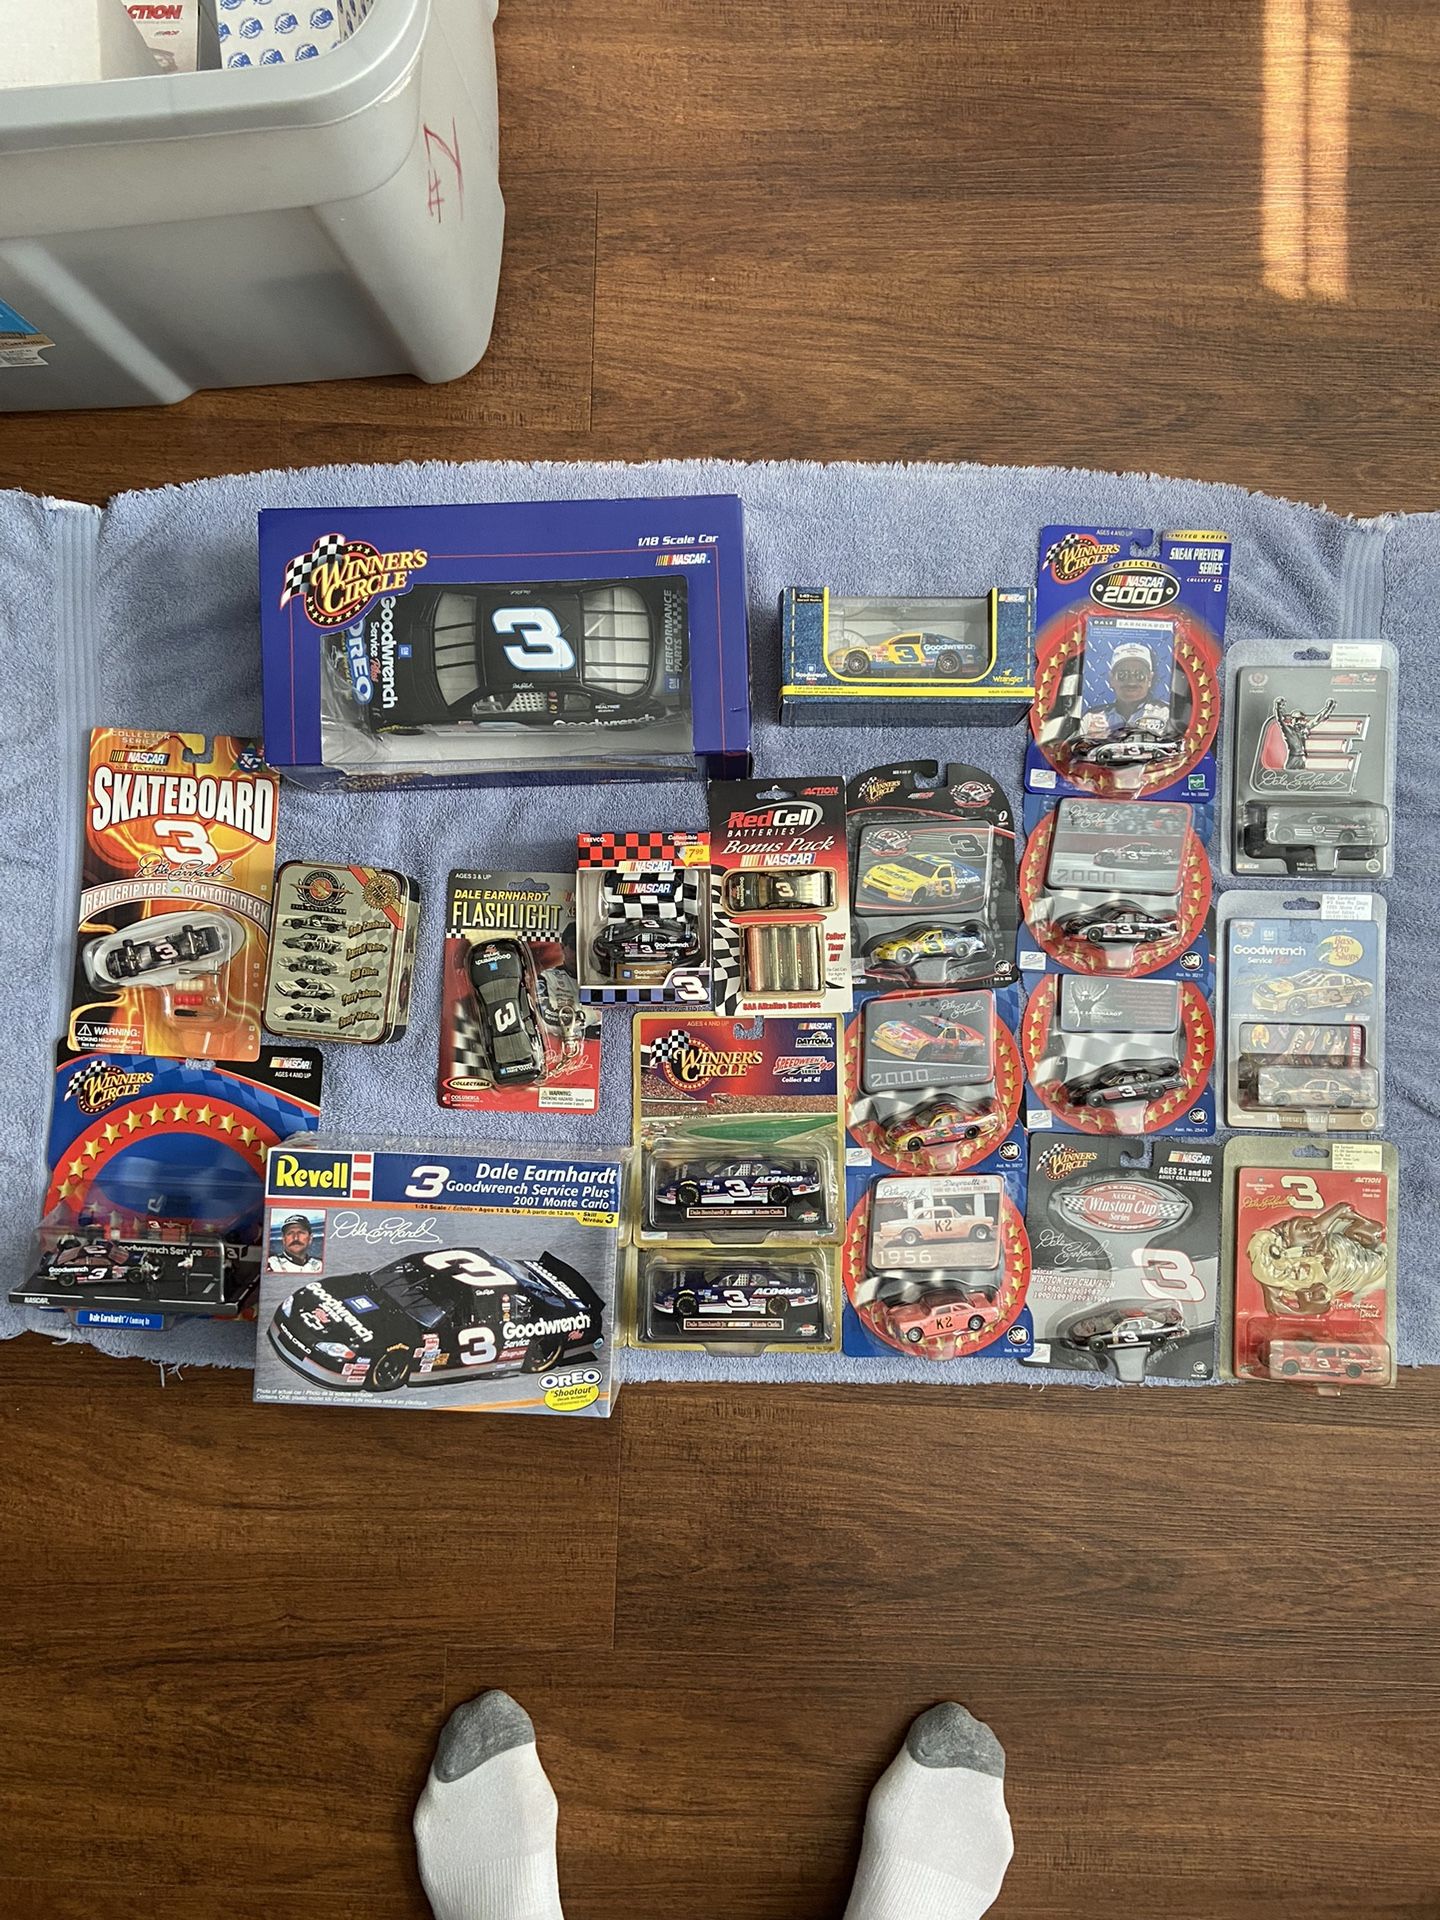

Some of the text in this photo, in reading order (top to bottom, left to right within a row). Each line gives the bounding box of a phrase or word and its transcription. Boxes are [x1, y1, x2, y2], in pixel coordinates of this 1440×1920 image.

[124, 5, 183, 19] CTION
[637, 534, 719, 547] 1/18 Scale Car
[671, 552, 707, 566] NASCAR
[1060, 542, 1121, 568] WINNER'S
[1169, 547, 1225, 561] SNEAK PREVIEW
[1064, 555, 1109, 574] CIRCLE
[1112, 560, 1164, 570] OFFICIAL
[1198, 561, 1223, 575] SERIES
[311, 549, 427, 598] WINNER'S
[1125, 575, 1165, 587] NASCAR
[1213, 584, 1222, 592] 8
[323, 571, 408, 614] CIRCLE
[1102, 586, 1163, 605] 2000
[663, 589, 673, 673] PERFORMANCE
[370, 621, 379, 657] Service
[491, 606, 576, 672] 3
[380, 596, 398, 709] Goodwrench
[673, 638, 683, 673] PARTS
[1128, 745, 1141, 756] 3
[127, 752, 166, 765] NASCAR
[803, 786, 839, 796] ACTION
[92, 765, 275, 845] SKATEBOARD
[728, 808, 814, 828] RedCell
[727, 827, 795, 837] BATTERIES
[153, 818, 219, 865] 3
[721, 835, 835, 854] Bonus Pack
[948, 833, 986, 859] 3
[764, 853, 814, 865] NASCAR
[1126, 850, 1139, 860] 3
[635, 860, 669, 872] NASCAR
[1056, 869, 1116, 883] 2000
[454, 889, 549, 902] DALE EARNHARDT
[634, 883, 671, 894] NASCAR
[775, 881, 795, 898] 3
[85, 882, 269, 926] REAL GRIP TAPE CONTOUR DECK
[453, 901, 561, 930] FLASHLIGHT
[1119, 923, 1134, 934] 3
[1333, 936, 1354, 945] Bass
[155, 944, 178, 960] 3
[640, 944, 654, 954] 3
[1233, 944, 1306, 956] Goodwrench
[1332, 944, 1350, 954] Pro
[1334, 952, 1361, 962] Shops
[671, 975, 709, 1001] 3
[788, 1001, 822, 1010] Batteries
[494, 1001, 517, 1032] 3
[94, 1026, 140, 1037] WARNING:
[808, 1022, 832, 1030] NASCAR
[282, 1059, 310, 1070] NASCAR
[673, 1048, 763, 1069] WINNER'S
[775, 1057, 825, 1071] SPEEDWEEKS
[682, 1063, 748, 1082] CIRCLE
[871, 1068, 929, 1088] 2000
[83, 1072, 154, 1099] WINNER'S
[1121, 1085, 1137, 1098] 3
[89, 1085, 142, 1108] CIRCLE
[1050, 1151, 1098, 1168] WINNER'S
[1182, 1154, 1212, 1165] NASCAR
[275, 1154, 348, 1189] Revell
[475, 1163, 617, 1185] Dale Earnhardt
[1054, 1160, 1089, 1175] CIRCLE
[1158, 1166, 1213, 1177] AGES 21 and UP
[404, 1165, 450, 1199] 3
[754, 1175, 804, 1184] ACDelco
[1175, 1175, 1212, 1183] COLLECTABLE
[446, 1180, 611, 1199] Goodwrench Service Plus
[724, 1179, 750, 1197] 3
[1280, 1175, 1325, 1210] 3
[512, 1196, 610, 1210] 2001 Monte Carlo
[1088, 1197, 1158, 1217] Winston Cup
[511, 1207, 521, 1215] Up
[532, 1208, 548, 1216] partir
[1108, 1213, 1131, 1222] Series
[605, 1214, 615, 1224] 3
[226, 1247, 238, 1259] 3
[878, 1249, 932, 1265] 1956
[48, 1265, 89, 1274] Goodwrench
[88, 1268, 108, 1280] 3
[422, 1250, 517, 1287] 3
[1131, 1248, 1207, 1303] 3
[1031, 1274, 1116, 1289] WINSTON CUP CHAMPION
[753, 1287, 802, 1296] ACDelco
[723, 1290, 750, 1308] 3
[89, 1313, 101, 1322] Dale
[306, 1281, 374, 1343] Goodwrench
[502, 1312, 591, 1340] Goodwrench
[503, 1338, 531, 1349] Service
[1122, 1333, 1139, 1342] 3
[457, 1327, 497, 1364] 3
[1316, 1358, 1331, 1369] 3
[540, 1369, 600, 1389] OREO
[551, 1385, 596, 1399] "Shootout"
